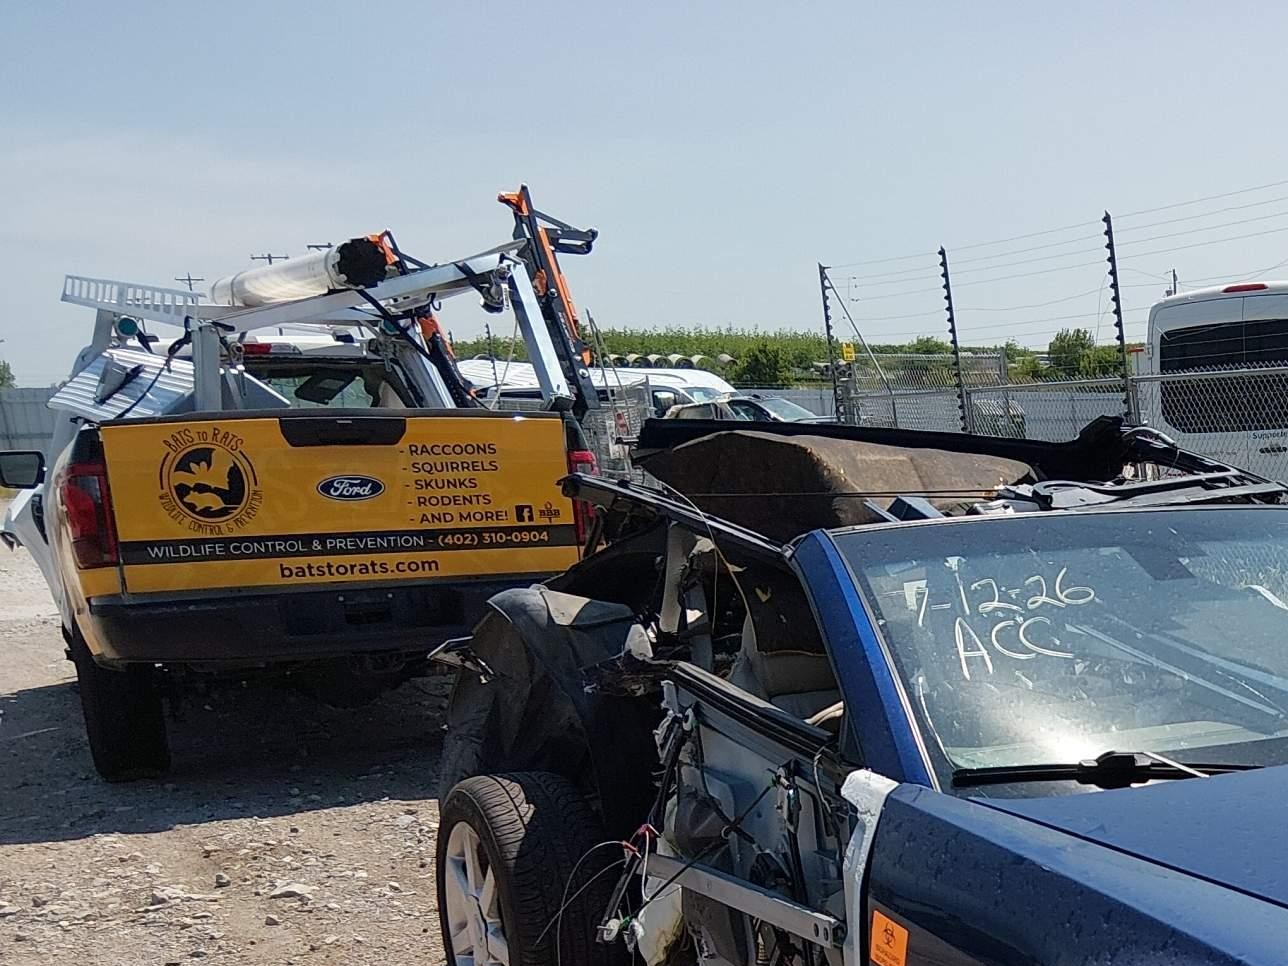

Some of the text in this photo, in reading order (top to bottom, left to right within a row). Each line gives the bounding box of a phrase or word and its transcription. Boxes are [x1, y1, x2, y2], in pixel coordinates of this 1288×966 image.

[163, 428, 195, 453] BATS
[212, 427, 244, 451] RATS
[408, 443, 497, 456] RACCOONS
[411, 460, 498, 475] SQUIRRELS
[330, 479, 372, 496] Ford
[414, 477, 478, 490] SKUNKS
[417, 494, 492, 507] RODENTS
[420, 512, 454, 524] AND
[459, 510, 508, 522] MORE!
[188, 520, 224, 536] CONTROL
[147, 543, 225, 558] WILDLIFE
[230, 540, 308, 554] CONTROL
[311, 539, 322, 550] &
[326, 535, 424, 550] PREVENTION
[438, 534, 478, 547] (402)
[482, 531, 549, 544] 310-0904
[280, 559, 439, 578] batstorats.com
[955, 616, 1074, 681] ACC
